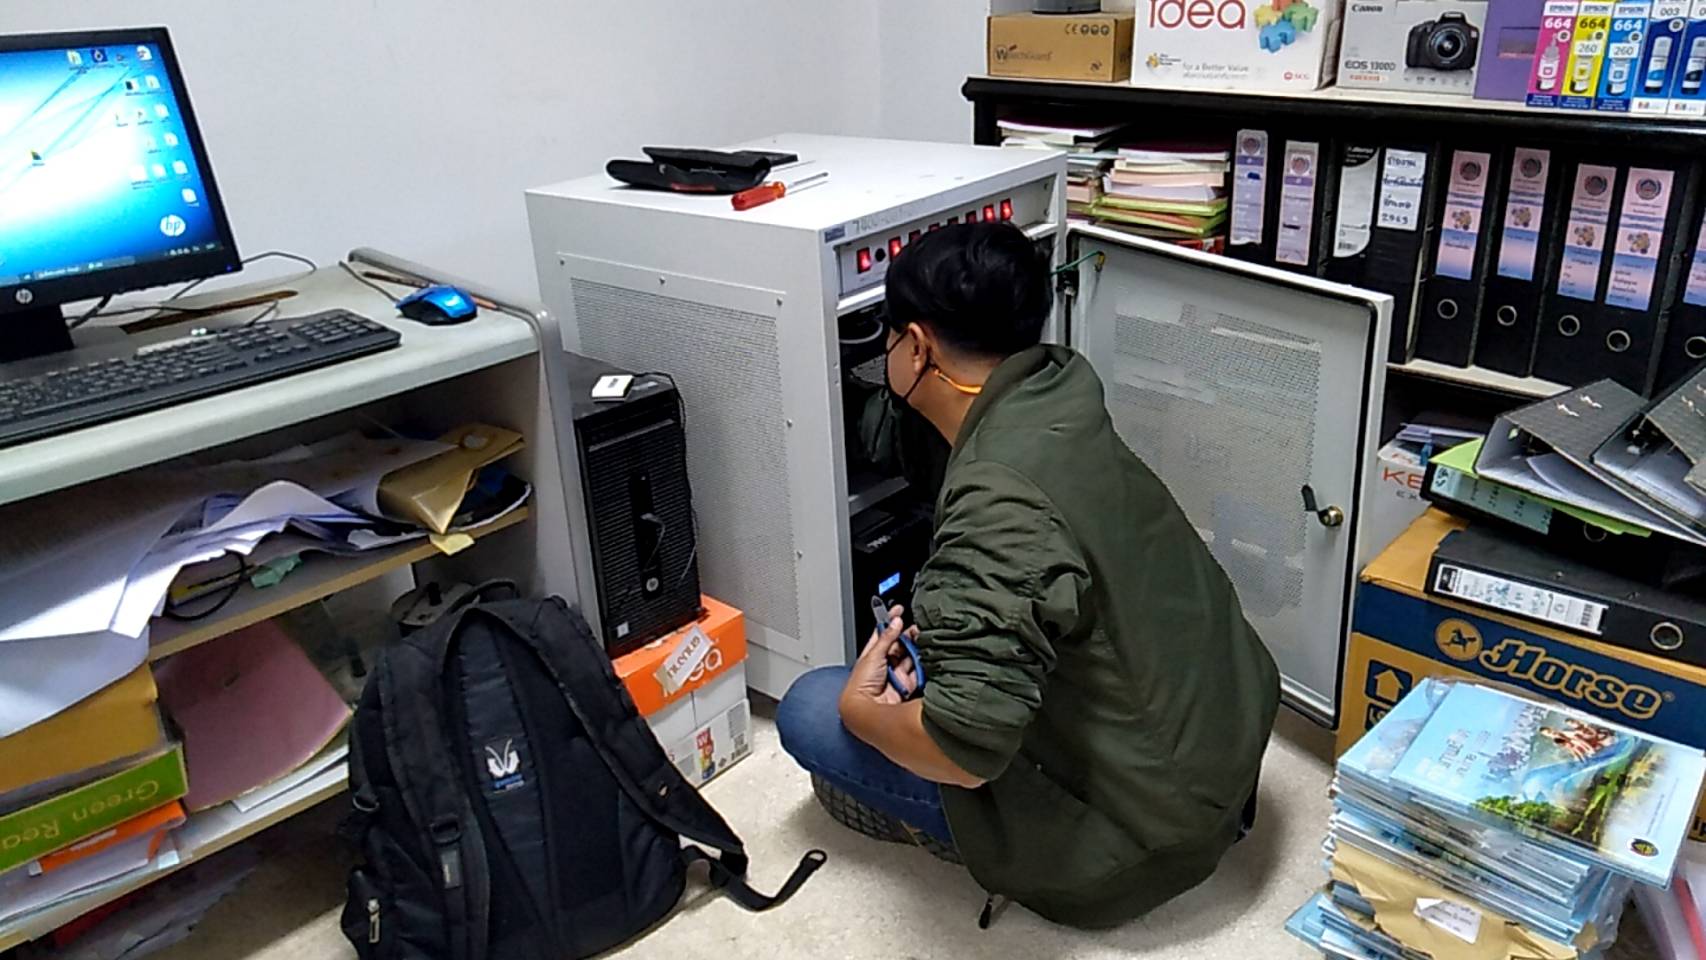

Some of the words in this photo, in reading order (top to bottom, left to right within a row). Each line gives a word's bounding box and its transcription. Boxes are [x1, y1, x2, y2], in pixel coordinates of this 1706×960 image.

[1351, 3, 1383, 12] Canon
[1549, 5, 1574, 13] EPSON
[1584, 5, 1609, 13] EPSON
[1618, 6, 1644, 14] EPSON
[1659, 7, 1680, 16] 003
[1544, 18, 1572, 29] 664
[1579, 18, 1607, 30] 664
[1613, 19, 1643, 31] 664
[1578, 43, 1598, 53] 260
[1613, 45, 1634, 56] 260
[1344, 60, 1368, 70] EOS
[163, 215, 183, 236] hp
[1479, 638, 1663, 720] Horse
[71, 780, 159, 822] Green
